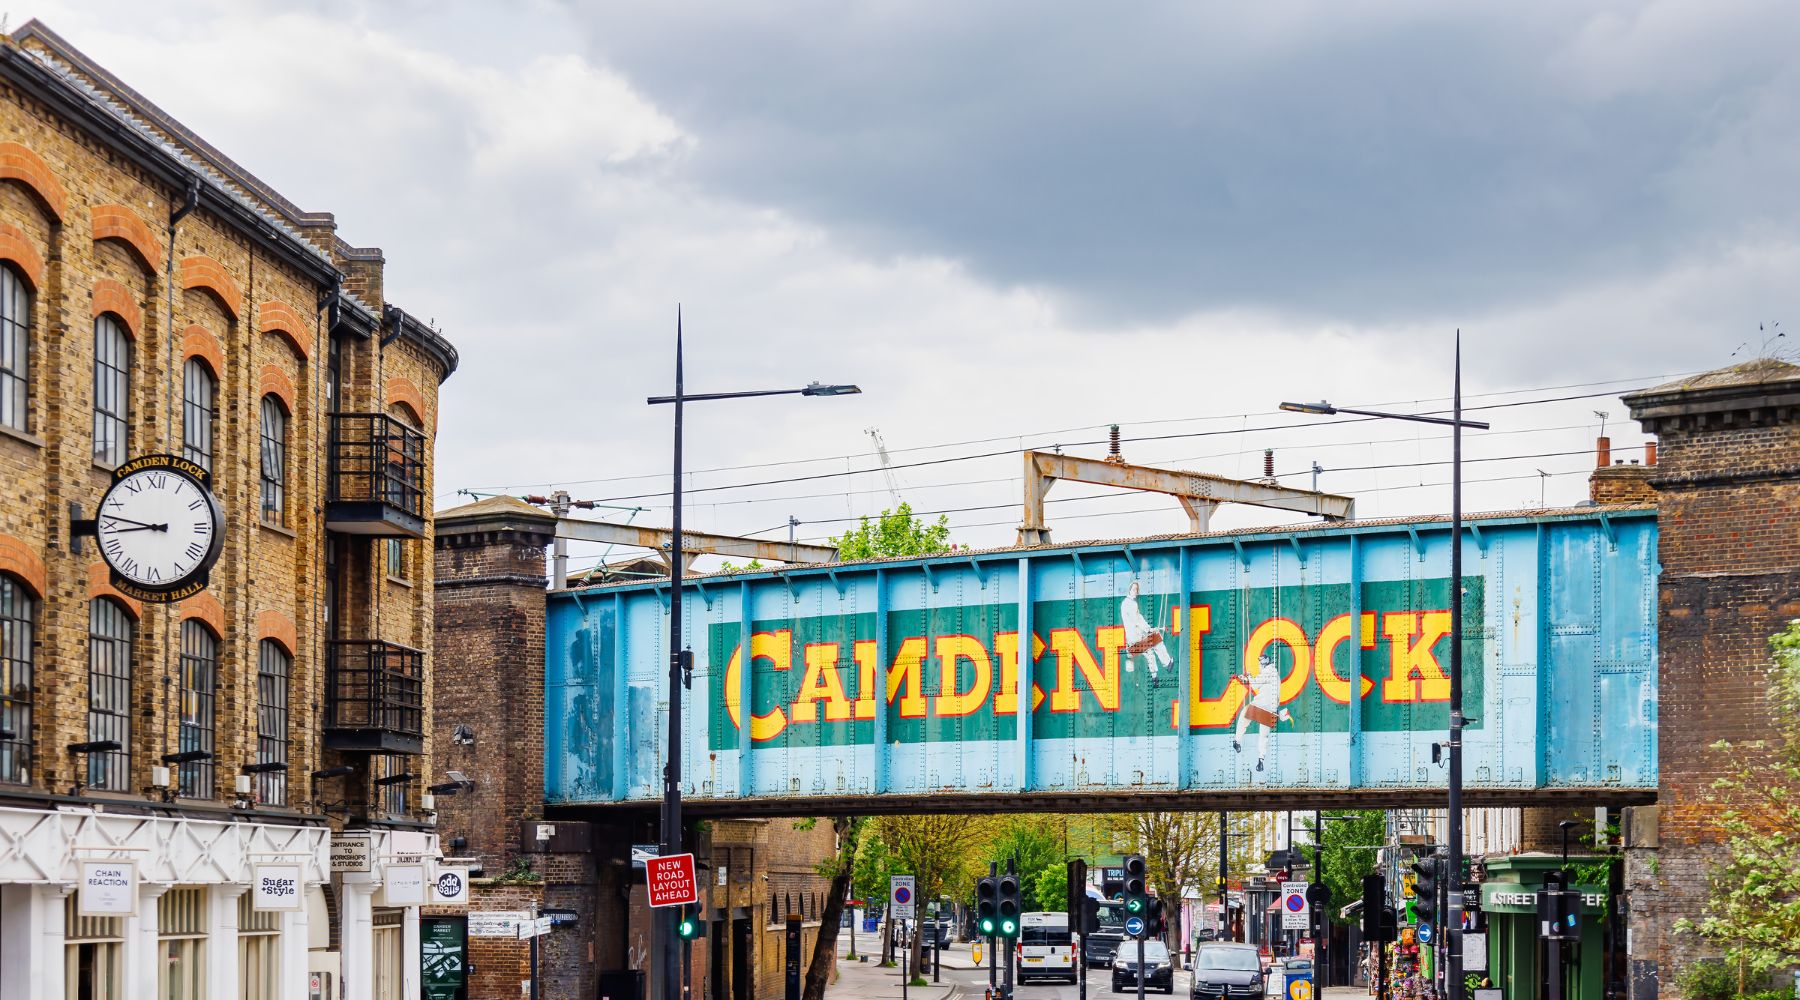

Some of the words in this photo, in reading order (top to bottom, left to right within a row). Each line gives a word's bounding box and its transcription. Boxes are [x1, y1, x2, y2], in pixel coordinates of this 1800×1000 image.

[117, 457, 170, 478] CAMDEN
[172, 458, 207, 481] LOCK
[147, 475, 167, 489] XII
[109, 497, 124, 511] X
[194, 523, 207, 534] III
[116, 579, 168, 601] MARKET
[171, 583, 204, 601] HALL
[724, 625, 1127, 742] CAMDEN
[1171, 603, 1452, 729] LOCK
[658, 860, 681, 871] NEW
[88, 878, 128, 886] REACTION
[440, 874, 458, 888] odd
[656, 870, 685, 881] ROAD
[262, 877, 294, 888] Sugar
[653, 879, 690, 892] LAYOUT
[438, 884, 460, 896] balls
[655, 890, 690, 901] AHEAD
[1497, 892, 1538, 905] STREET
